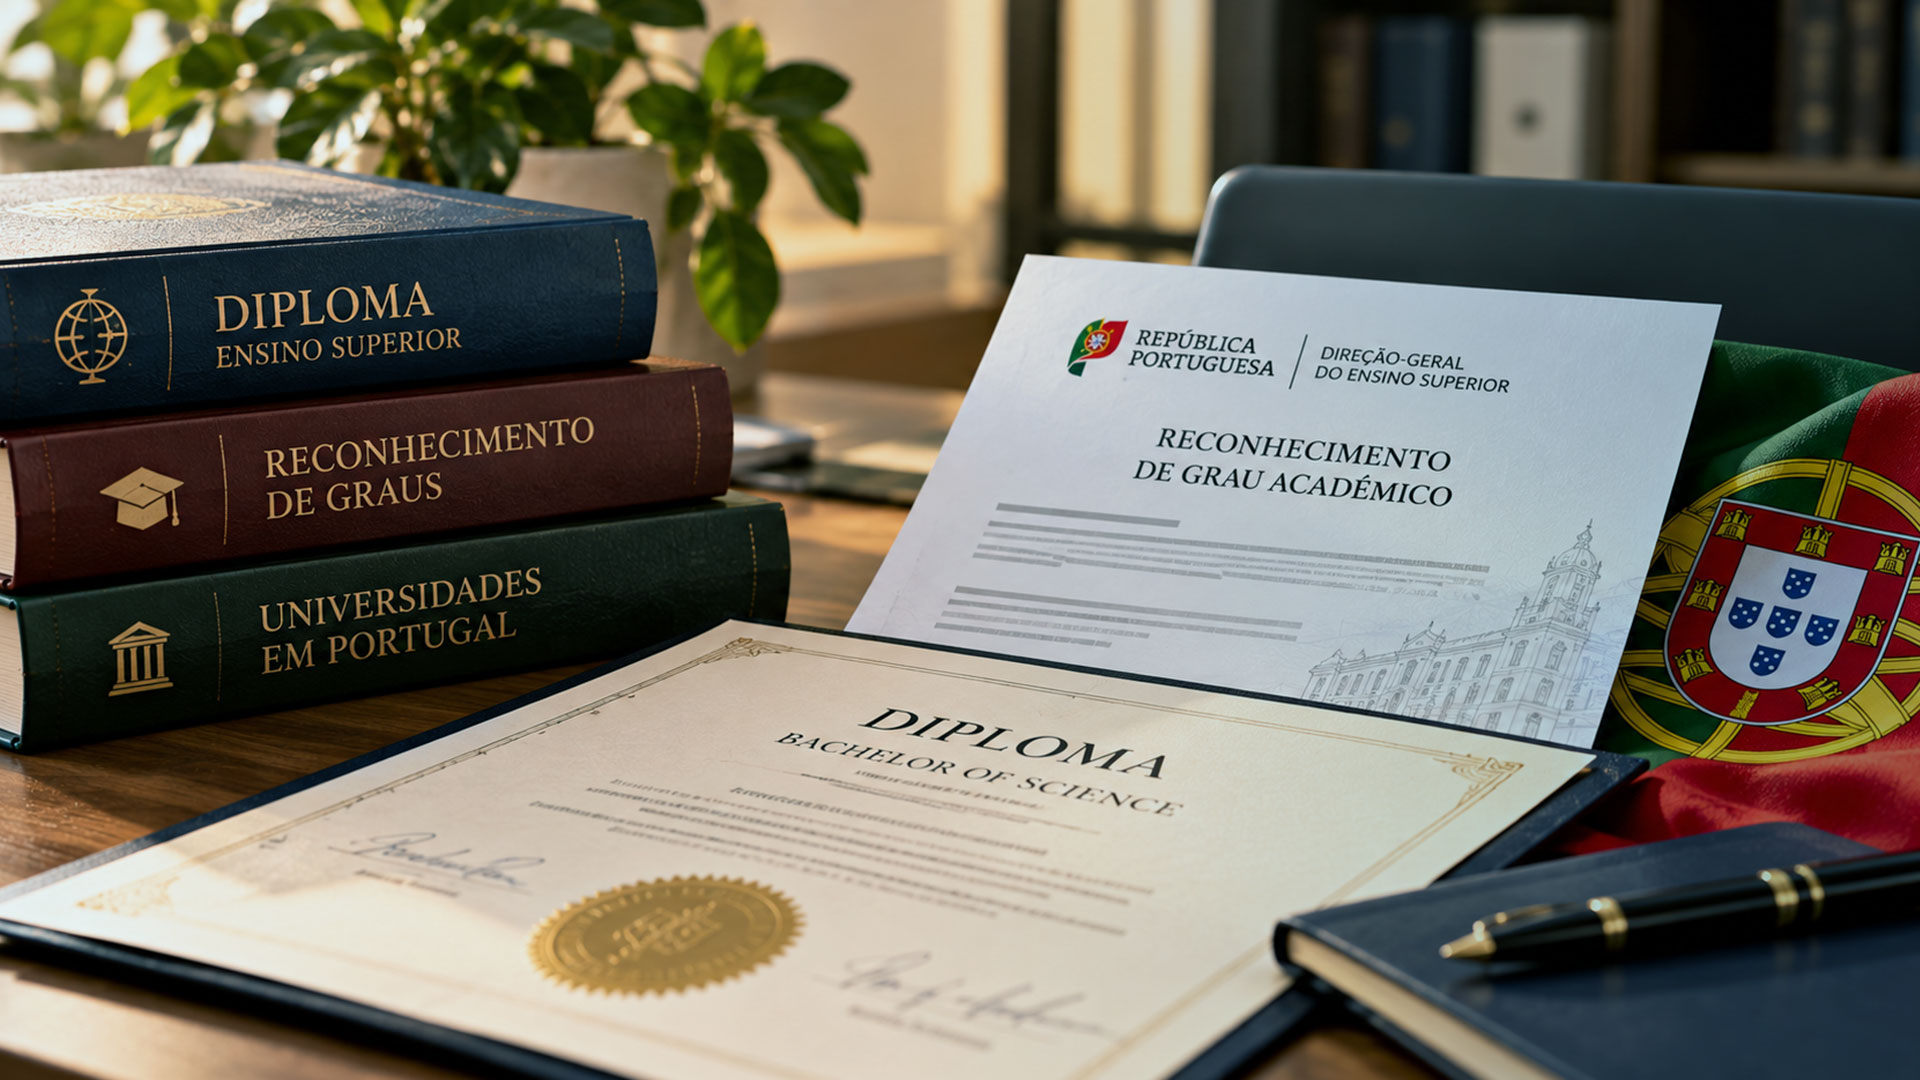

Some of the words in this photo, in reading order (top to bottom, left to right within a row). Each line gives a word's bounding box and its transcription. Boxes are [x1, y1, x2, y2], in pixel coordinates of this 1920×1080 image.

[214, 281, 434, 332] DIPLOMA
[216, 338, 322, 369] ENSINO
[332, 328, 462, 359] SUPERIOR
[1128, 350, 1275, 377] PORTUGUESA
[1136, 329, 1256, 355] REPÚBLICA
[1321, 345, 1465, 371] DIREÇÃO-GERAL
[1315, 365, 1344, 383] DO
[1347, 368, 1416, 387] ENSINO
[1419, 373, 1510, 393] SUPERIOR
[264, 416, 594, 478] RECONHECIMENTO
[1157, 428, 1451, 472] RECONHECIMENTO
[266, 487, 315, 520] DE
[326, 472, 442, 511] GRAUS
[1133, 460, 1175, 482] DE
[1181, 464, 1264, 490] GRAU
[1268, 471, 1453, 507] ACADÉMICO
[259, 567, 541, 632] UNIVERSIDADES
[262, 639, 315, 675] EM
[327, 611, 516, 664] PORTUGAL
[858, 707, 1166, 779] DIPLOMA
[774, 732, 956, 775] BACHELOR
[962, 766, 1014, 783] OF
[1017, 776, 1184, 817] SCIENCE
